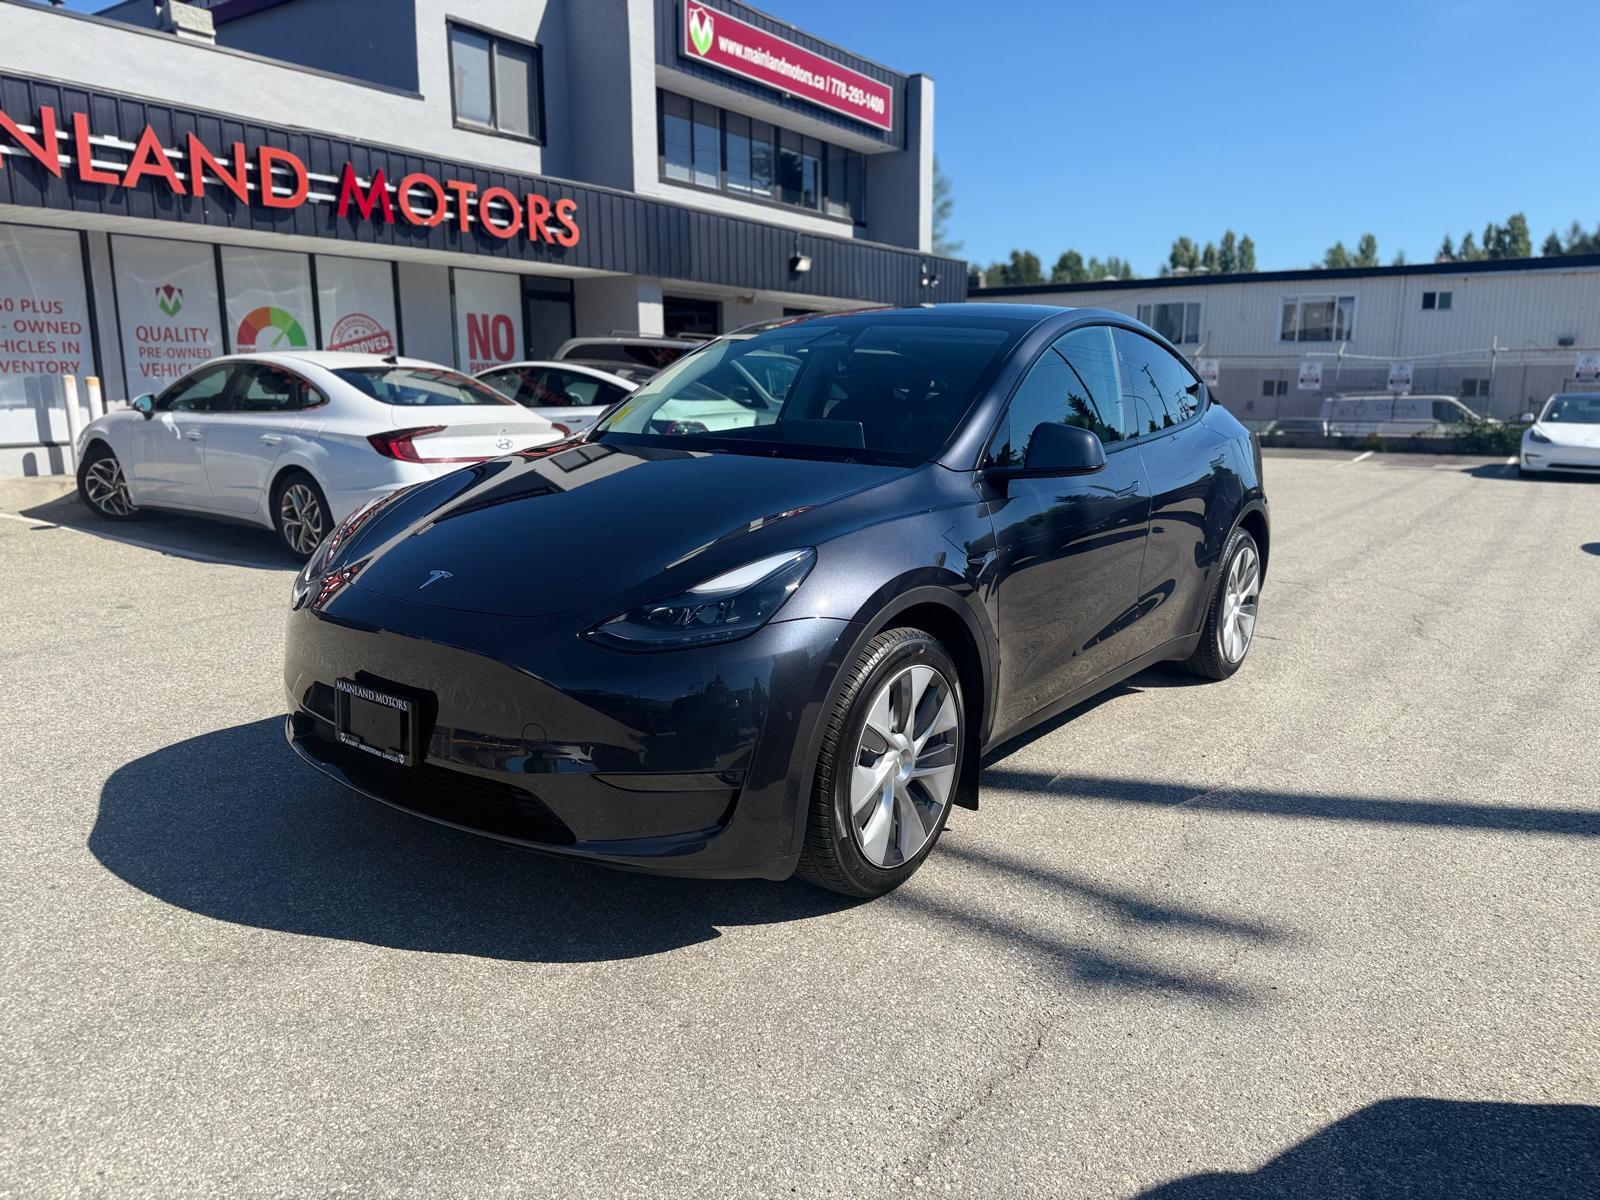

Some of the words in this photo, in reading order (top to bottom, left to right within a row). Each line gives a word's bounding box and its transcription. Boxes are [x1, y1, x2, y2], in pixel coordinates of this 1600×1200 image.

[718, 35, 825, 89] www.mainlandmotors.ca
[830, 78, 885, 114] 778-293-1400
[337, 161, 580, 248] MOTORS
[20, 298, 64, 314] PLUS
[13, 319, 82, 335] OWNED
[135, 325, 209, 343] QUALITY
[466, 313, 515, 362] NO
[62, 341, 81, 355] IN
[138, 346, 212, 359] PRE-OWNED
[336, 680, 374, 701] MAINLAND
[375, 692, 408, 711] MOTORS
